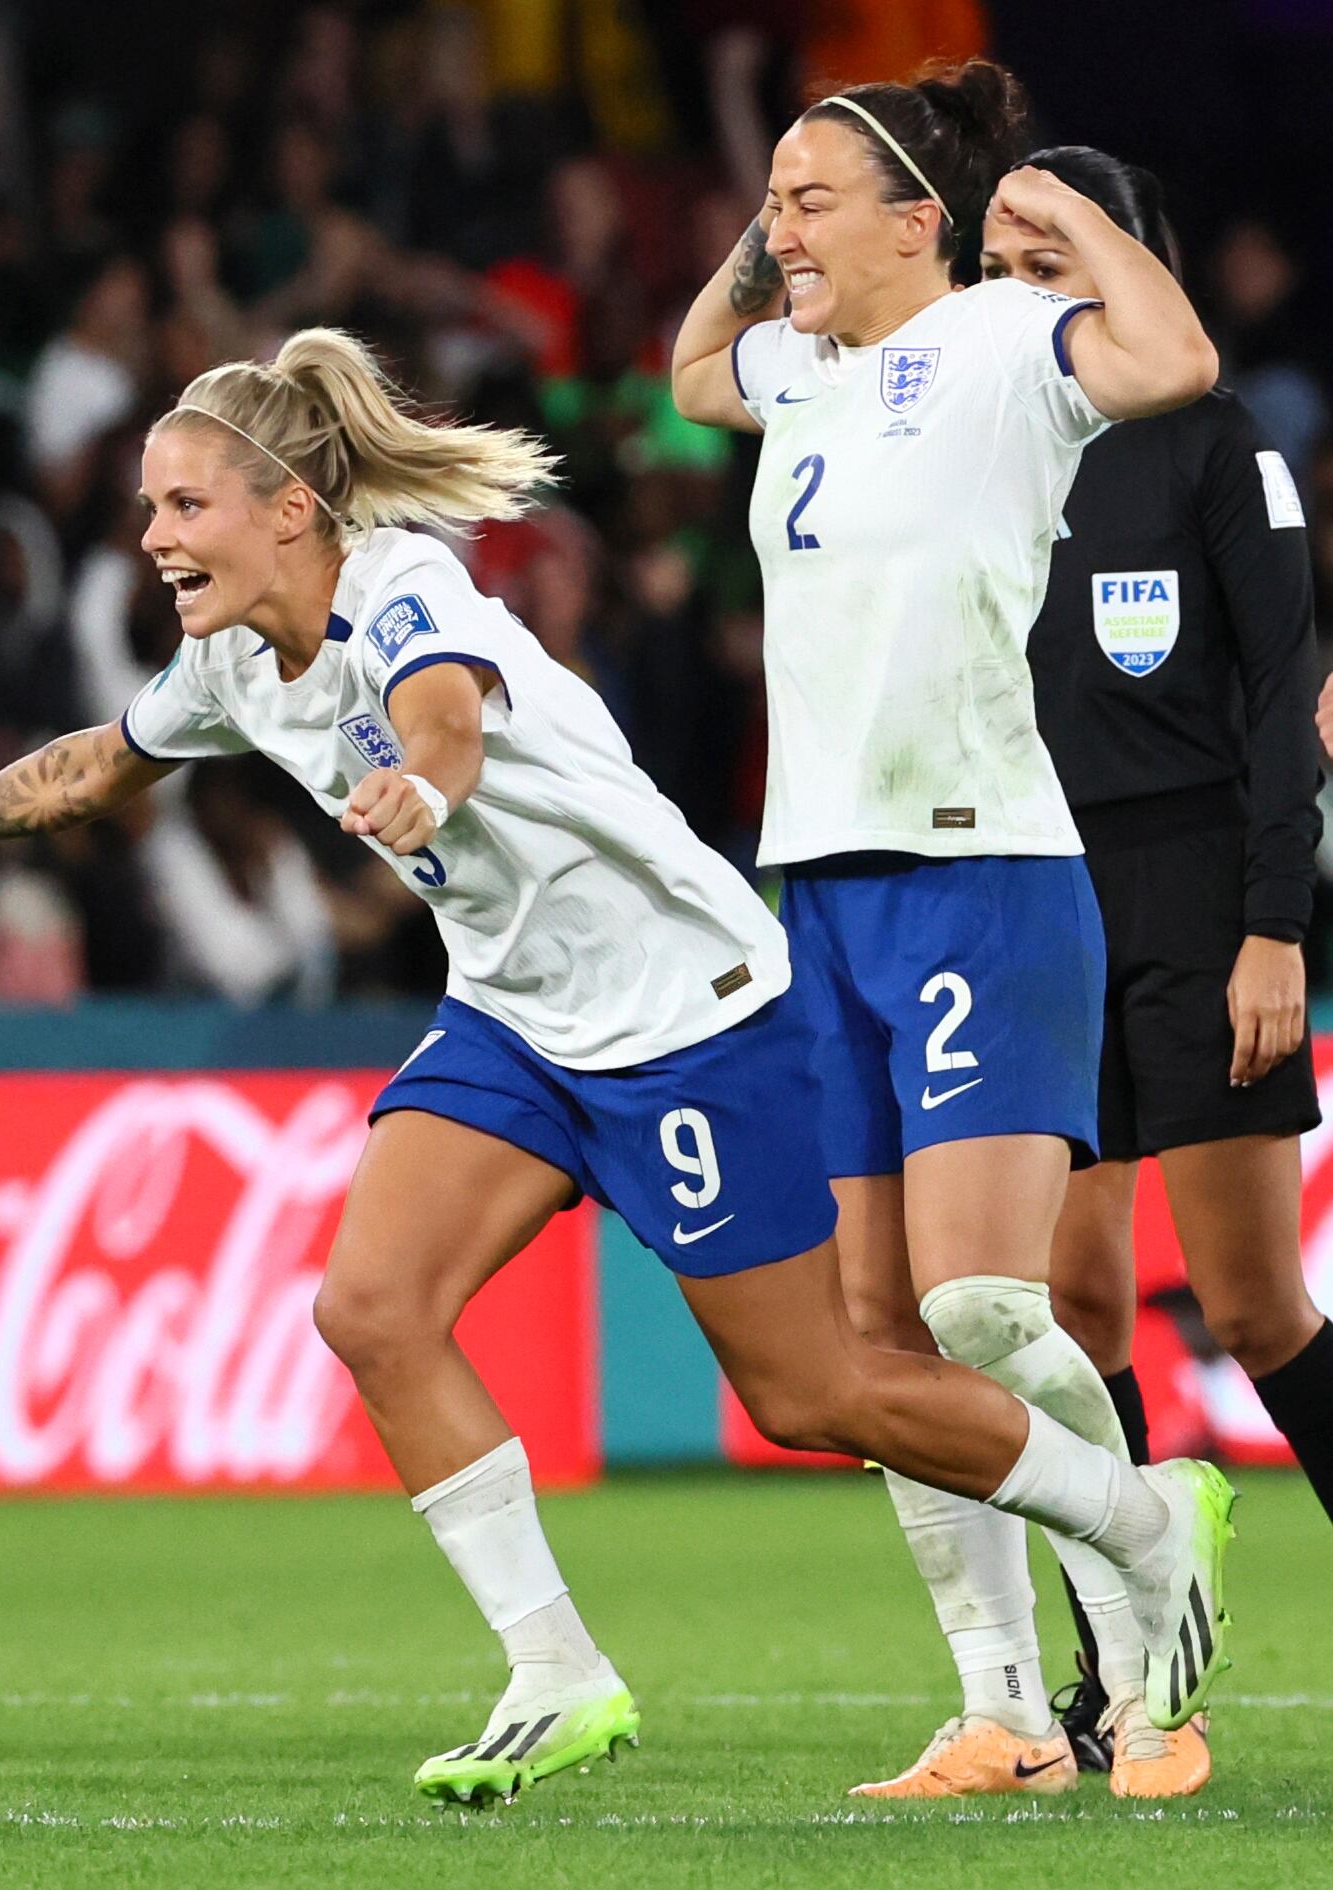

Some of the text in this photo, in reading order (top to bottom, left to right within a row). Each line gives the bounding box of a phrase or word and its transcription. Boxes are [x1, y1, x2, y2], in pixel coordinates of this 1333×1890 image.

[787, 454, 825, 551] 2
[1102, 580, 1169, 604] FIFA
[1104, 615, 1170, 626] ASSISTANT
[1110, 627, 1166, 639] REFEREE
[1122, 653, 1154, 666] 2023
[920, 972, 979, 1072] 2
[660, 1108, 721, 1209] 9
